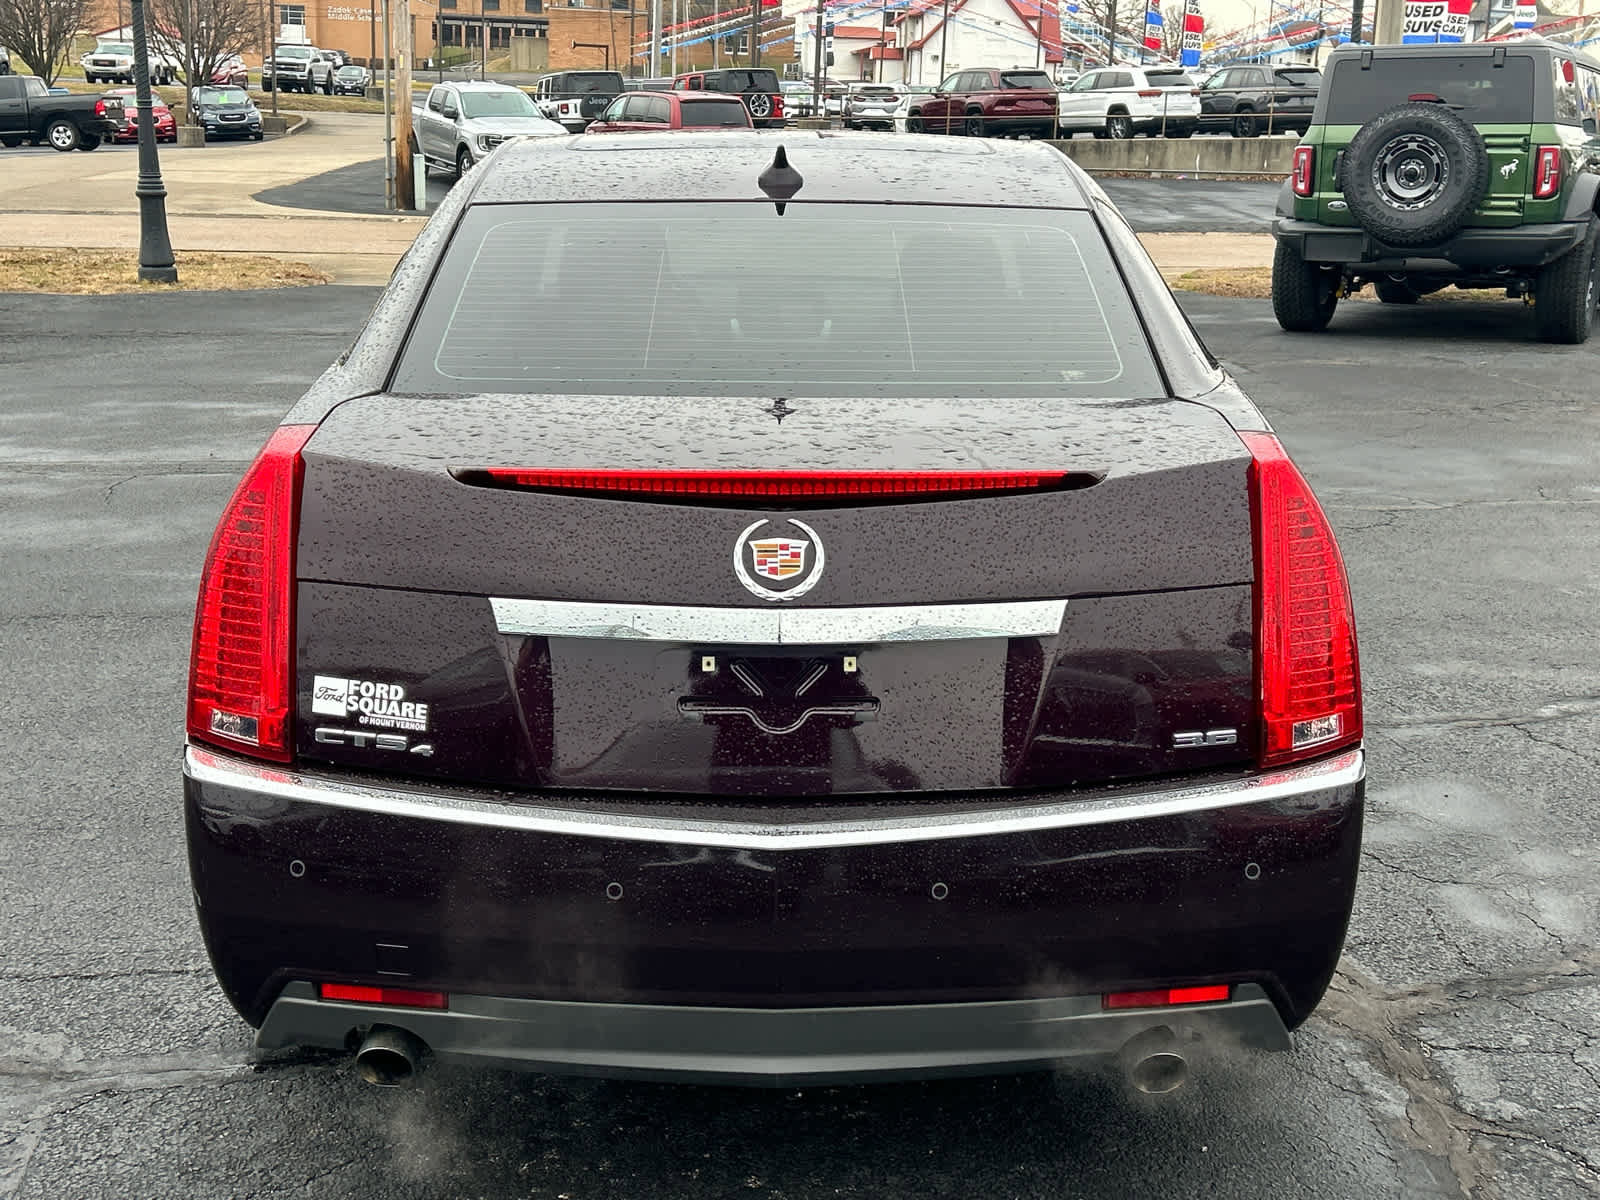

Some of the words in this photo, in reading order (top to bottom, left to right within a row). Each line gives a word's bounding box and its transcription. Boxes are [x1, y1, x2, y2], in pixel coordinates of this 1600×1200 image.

[1405, 5, 1444, 18] USED
[1403, 20, 1443, 33] SUVS
[1447, 15, 1468, 25] SE
[1442, 24, 1466, 34] CAR
[315, 686, 345, 703] Ford
[348, 679, 404, 701] FORD
[346, 695, 429, 720] SQUARE
[359, 715, 369, 725] OF
[369, 717, 395, 728] MOUNT
[395, 719, 427, 731] VERNON
